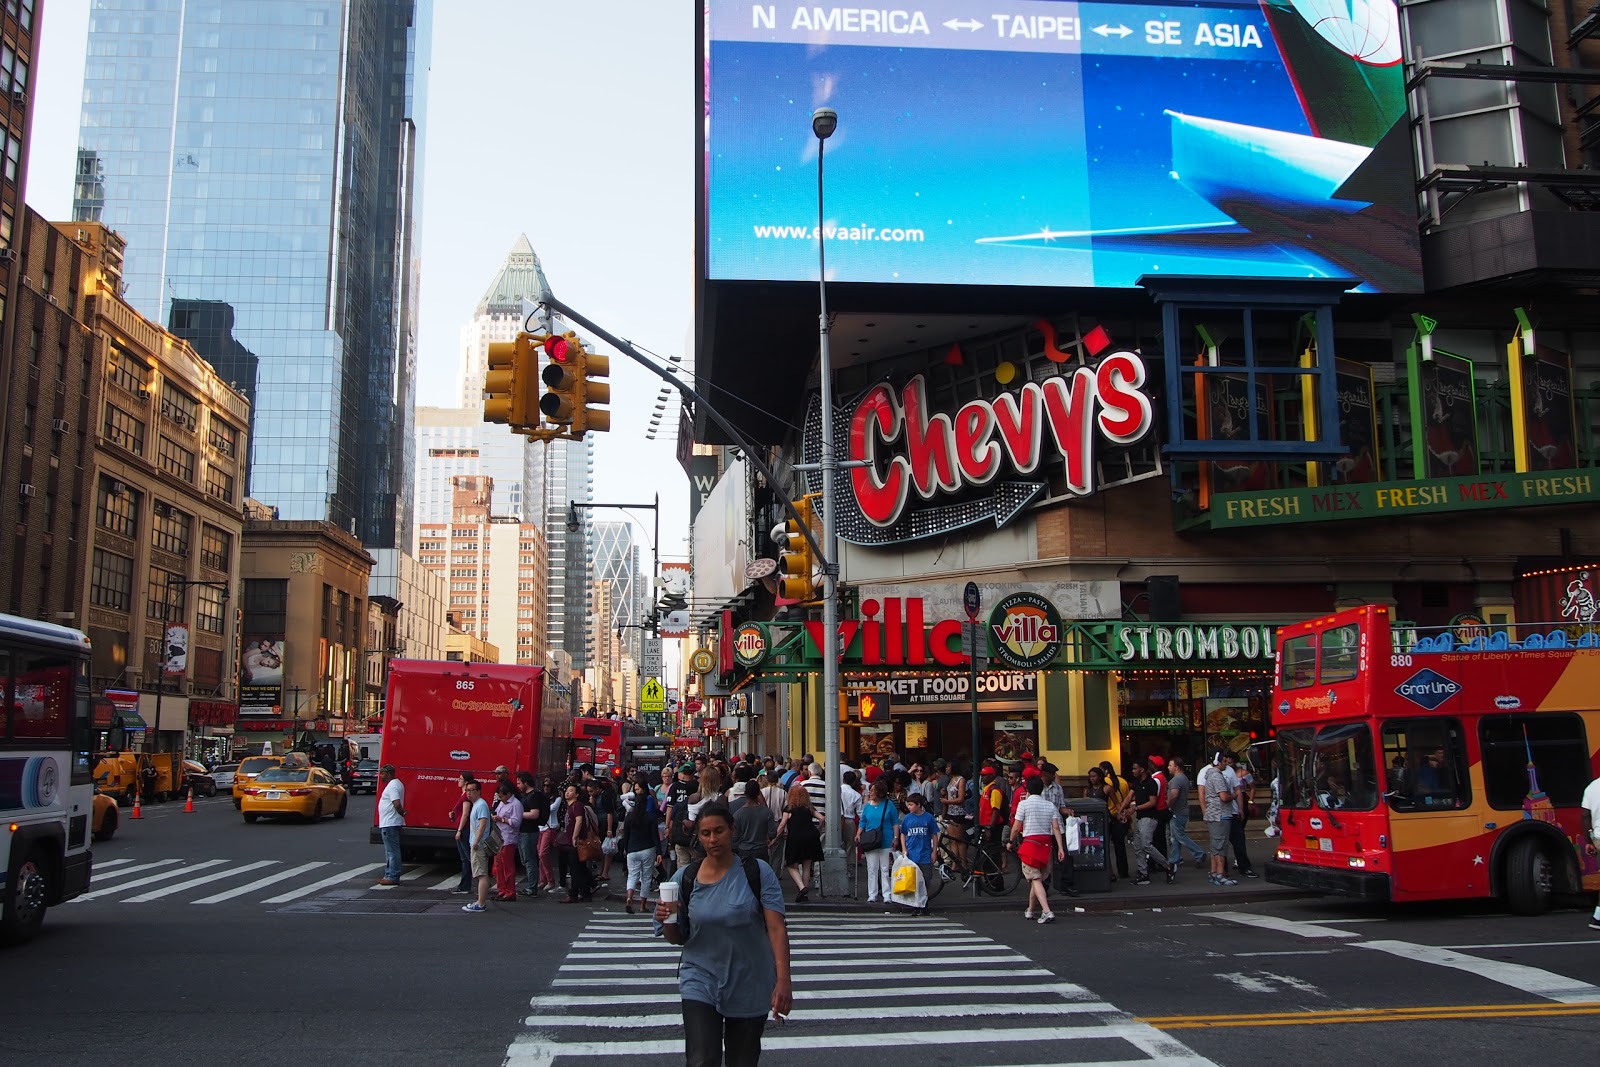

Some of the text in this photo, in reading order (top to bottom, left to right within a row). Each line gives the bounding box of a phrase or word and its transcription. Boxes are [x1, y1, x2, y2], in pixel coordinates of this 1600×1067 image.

[752, 5, 1263, 48] N AMERICA TAIPEI SE ASIA
[754, 222, 925, 242] www.evaair.com
[1226, 476, 1592, 519] FRESH MEX FRESH MEX FRESH
[865, 586, 900, 595] RECIPES
[1079, 582, 1088, 613] TALIAN
[1002, 597, 1048, 610] PIZZA PASTA
[803, 596, 981, 667] villa
[992, 616, 1058, 643] villa
[733, 635, 765, 651] villa
[1119, 626, 1276, 661] STROMBOL
[997, 646, 1033, 668] STROMBOLI
[1037, 645, 1057, 665] SALADS
[1391, 655, 1413, 667] 880
[1440, 653, 1470, 662] Statue
[1471, 652, 1481, 660] of
[1483, 651, 1512, 661] Liberty
[1520, 651, 1545, 659] Times
[1547, 650, 1579, 659] Square
[456, 680, 475, 690] 865
[853, 679, 919, 696] MARKET
[923, 677, 969, 694] FOOD
[976, 674, 1036, 693] COURT
[910, 693, 966, 703] AT TIMES SQUARE
[1121, 717, 1184, 727] INTERNET ACCESS
